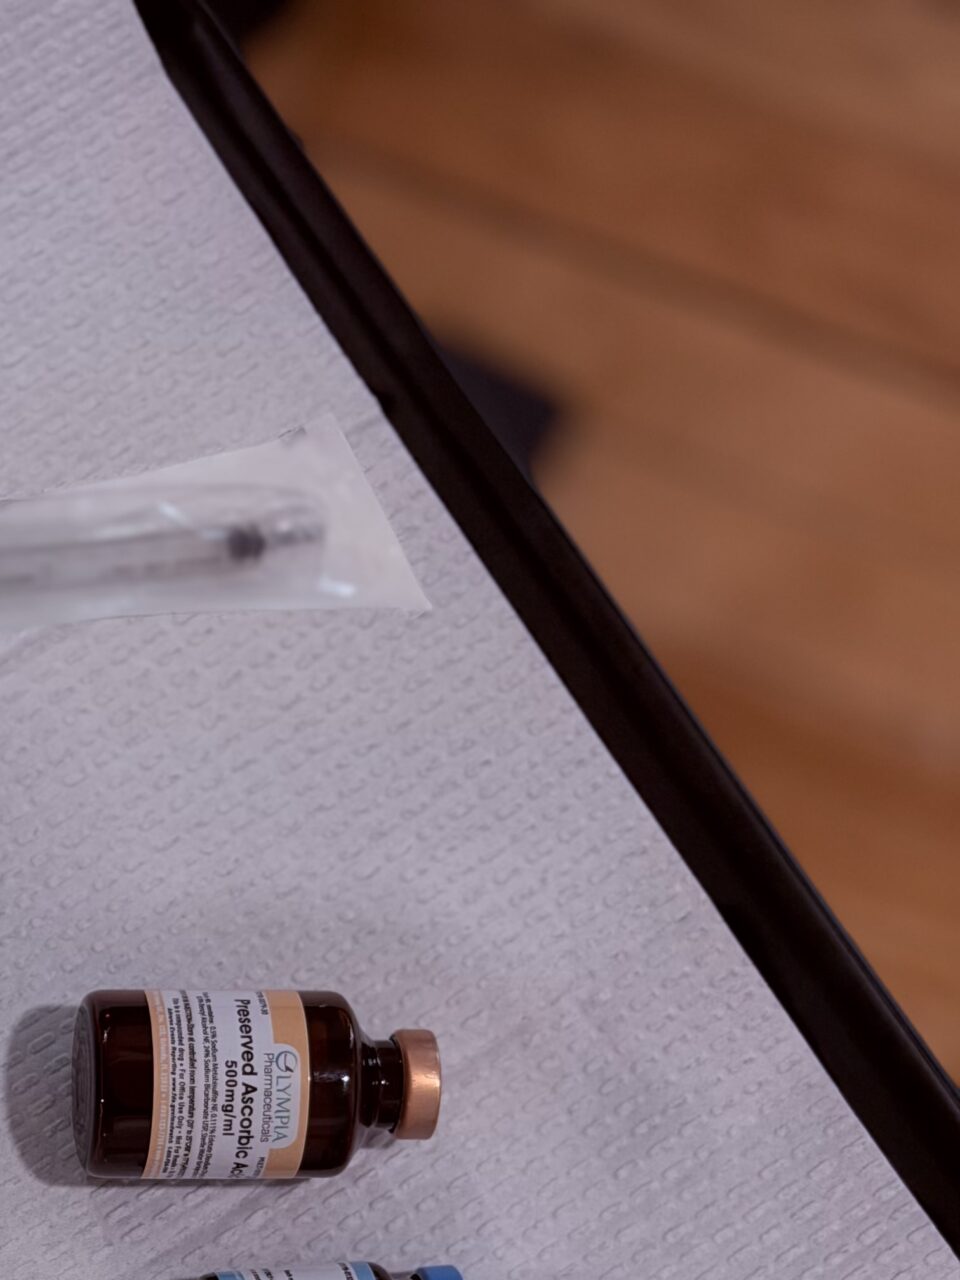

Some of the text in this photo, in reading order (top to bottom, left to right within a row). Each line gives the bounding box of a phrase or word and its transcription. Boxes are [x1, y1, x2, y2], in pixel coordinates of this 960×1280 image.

[234, 998, 257, 1075] Preserved
[221, 1060, 237, 1135] 500mg/ml
[234, 1082, 257, 1158] Ascorbic
[259, 1052, 274, 1142] Pharmaceuticals
